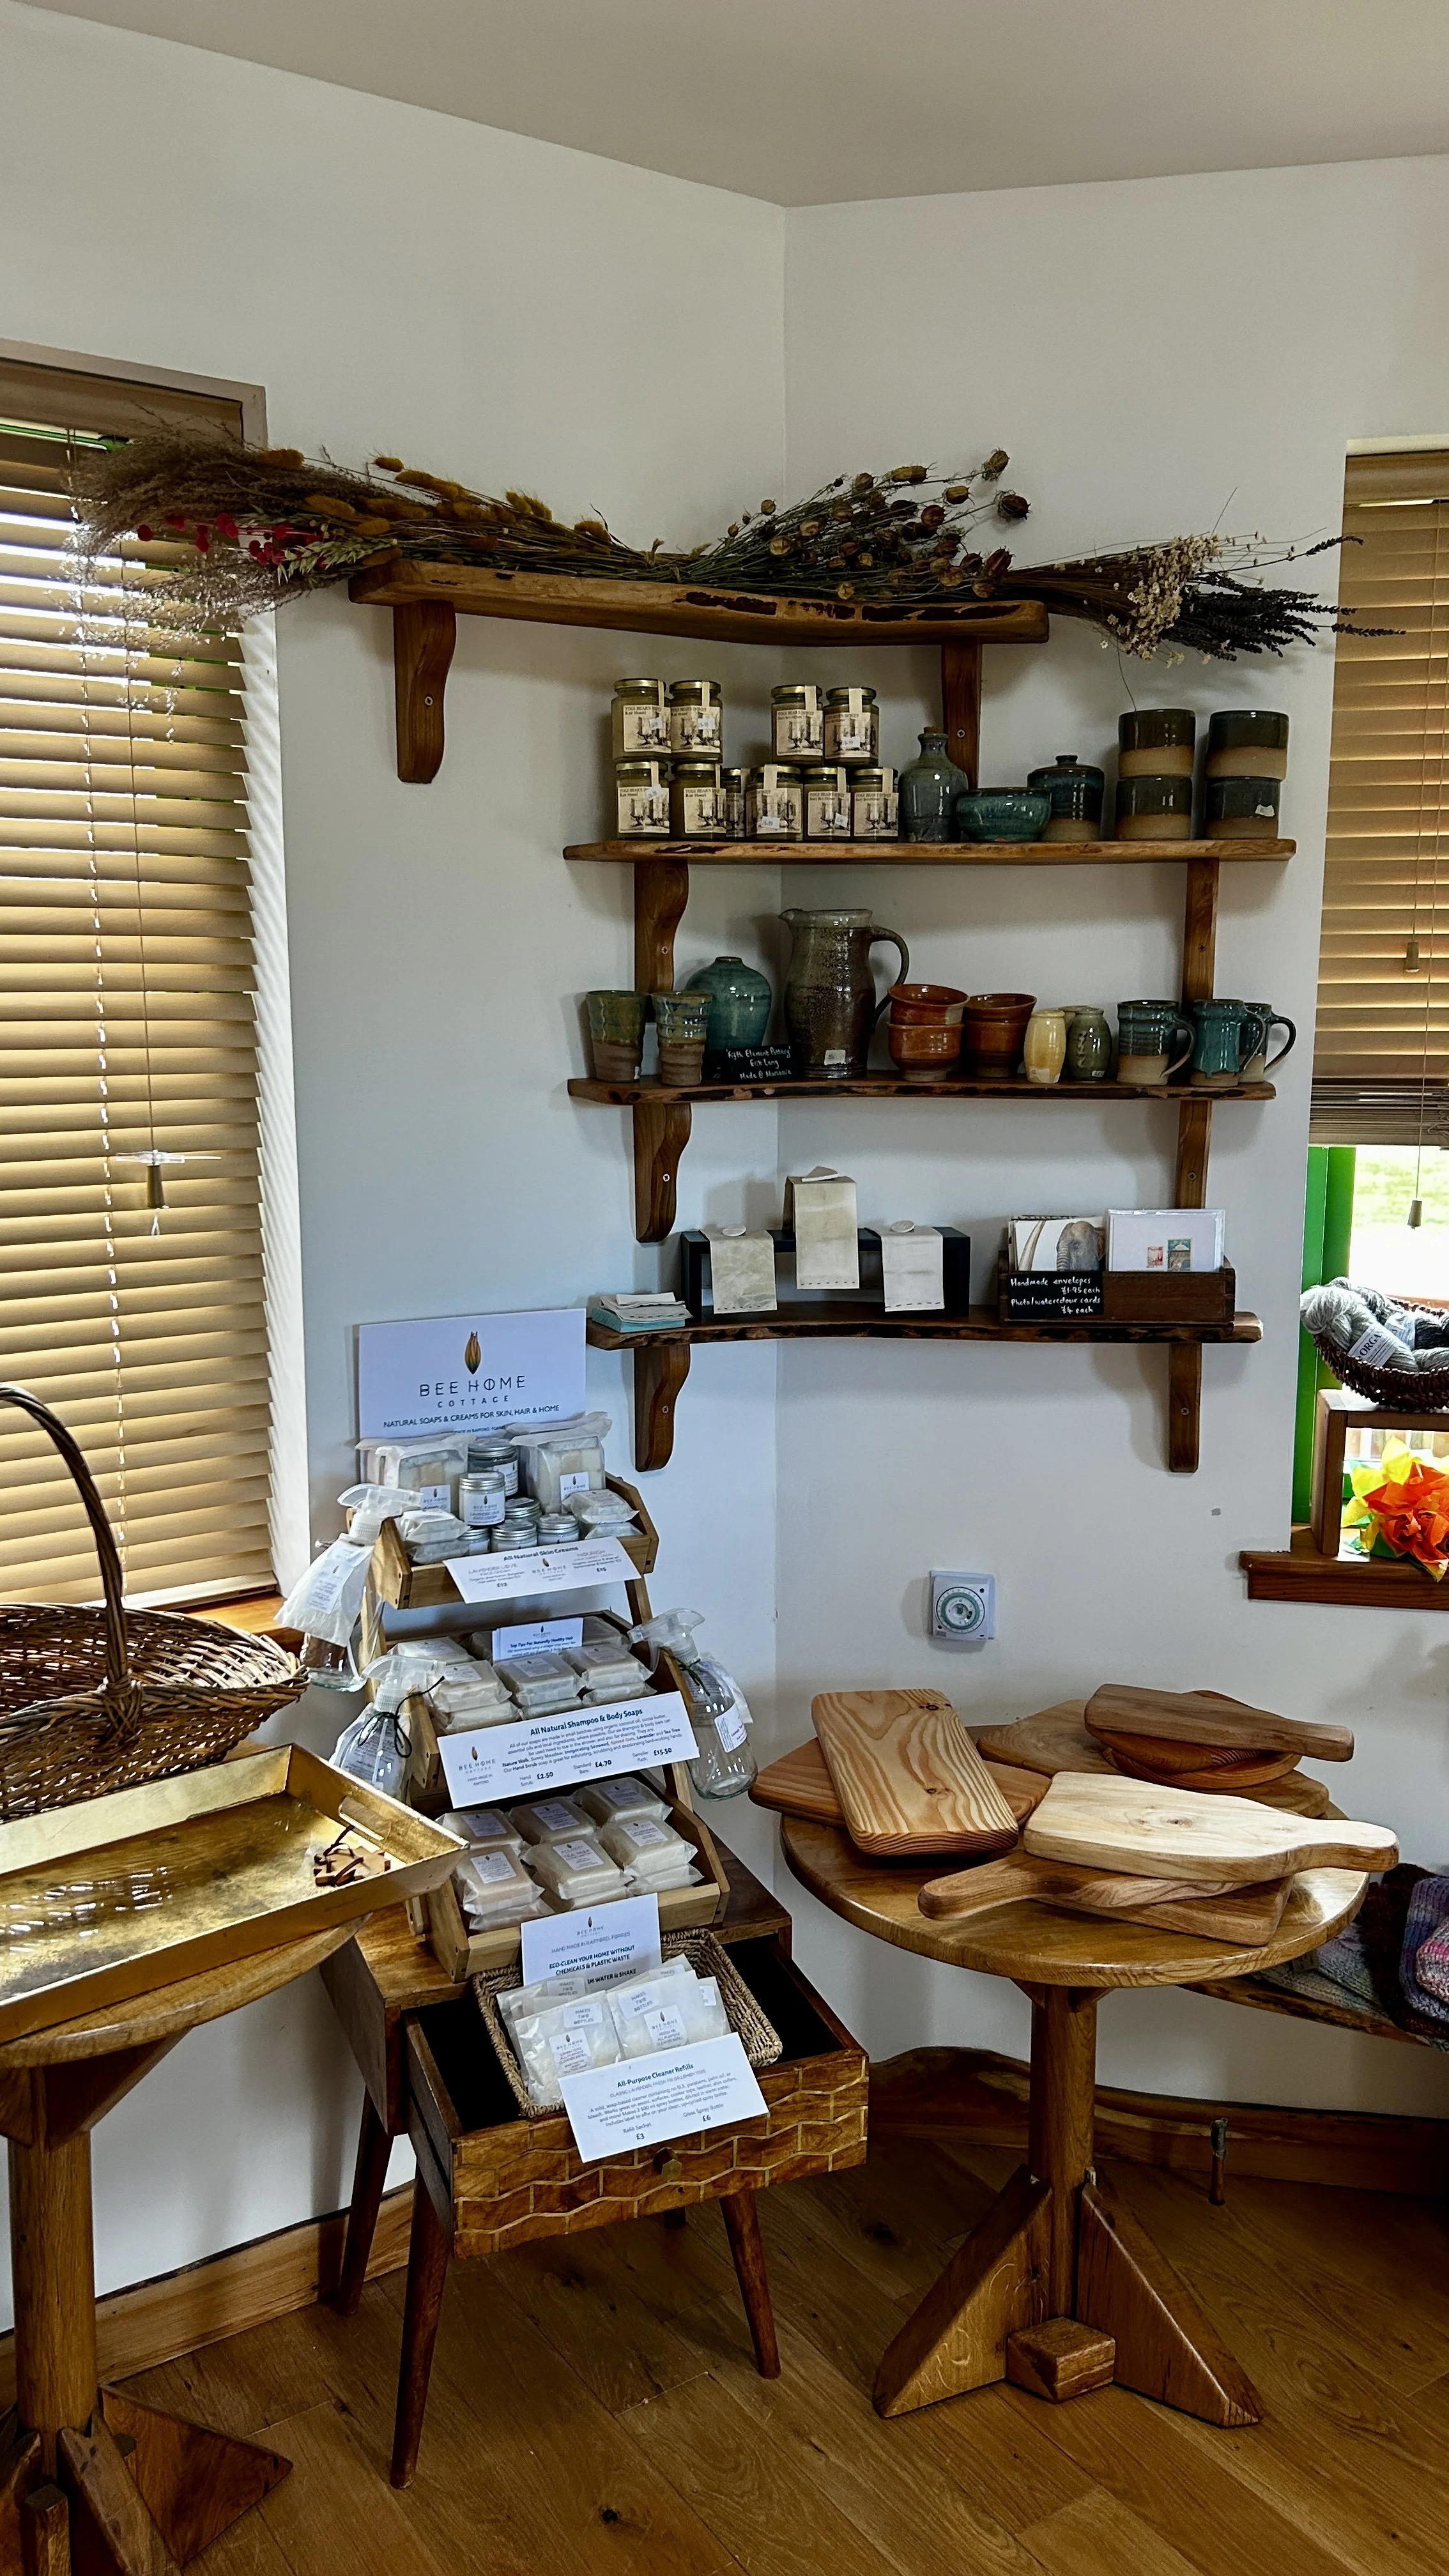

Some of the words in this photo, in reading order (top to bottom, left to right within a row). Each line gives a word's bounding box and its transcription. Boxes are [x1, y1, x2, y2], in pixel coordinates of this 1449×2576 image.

[745, 1048, 769, 1058] Element
[740, 1071, 756, 1080] Made
[1011, 1276, 1048, 1287] Handmade
[1053, 1275, 1091, 1287] envelopes
[1080, 1296, 1100, 1305] cards
[1061, 1305, 1073, 1314] £4
[1075, 1305, 1094, 1314] each
[419, 1381, 459, 1397] BEE
[468, 1375, 526, 1393] HOME
[437, 1395, 509, 1408] COTTAGE
[383, 1418, 417, 1429] NATURAL
[419, 1416, 442, 1425] SOAPS
[514, 1552, 539, 1560] Natural
[555, 1546, 579, 1554] Creams
[531, 1728, 540, 1736] All
[541, 1722, 567, 1733] Natural
[567, 1718, 599, 1728] Shampoo
[606, 1712, 622, 1721] Body
[475, 1759, 496, 1767] HOME
[551, 1945, 565, 1953] HAND
[566, 1943, 580, 1951] MADE
[549, 1958, 578, 1969] ECO-CLEAN
[578, 1955, 593, 1965] YOUR
[594, 1951, 610, 1961] HOME
[611, 1945, 635, 1958] WITHOUT
[556, 1964, 585, 1975] CHEMICALS
[591, 1958, 612, 1969] PLASTIC
[611, 1954, 630, 1965] WASTE
[594, 1974, 614, 1983] WATER
[618, 1969, 636, 1979] SHAKE
[618, 2076, 652, 2088] All-Purpose
[652, 2069, 675, 2078] Cleaner
[675, 2064, 694, 2073] Refills
